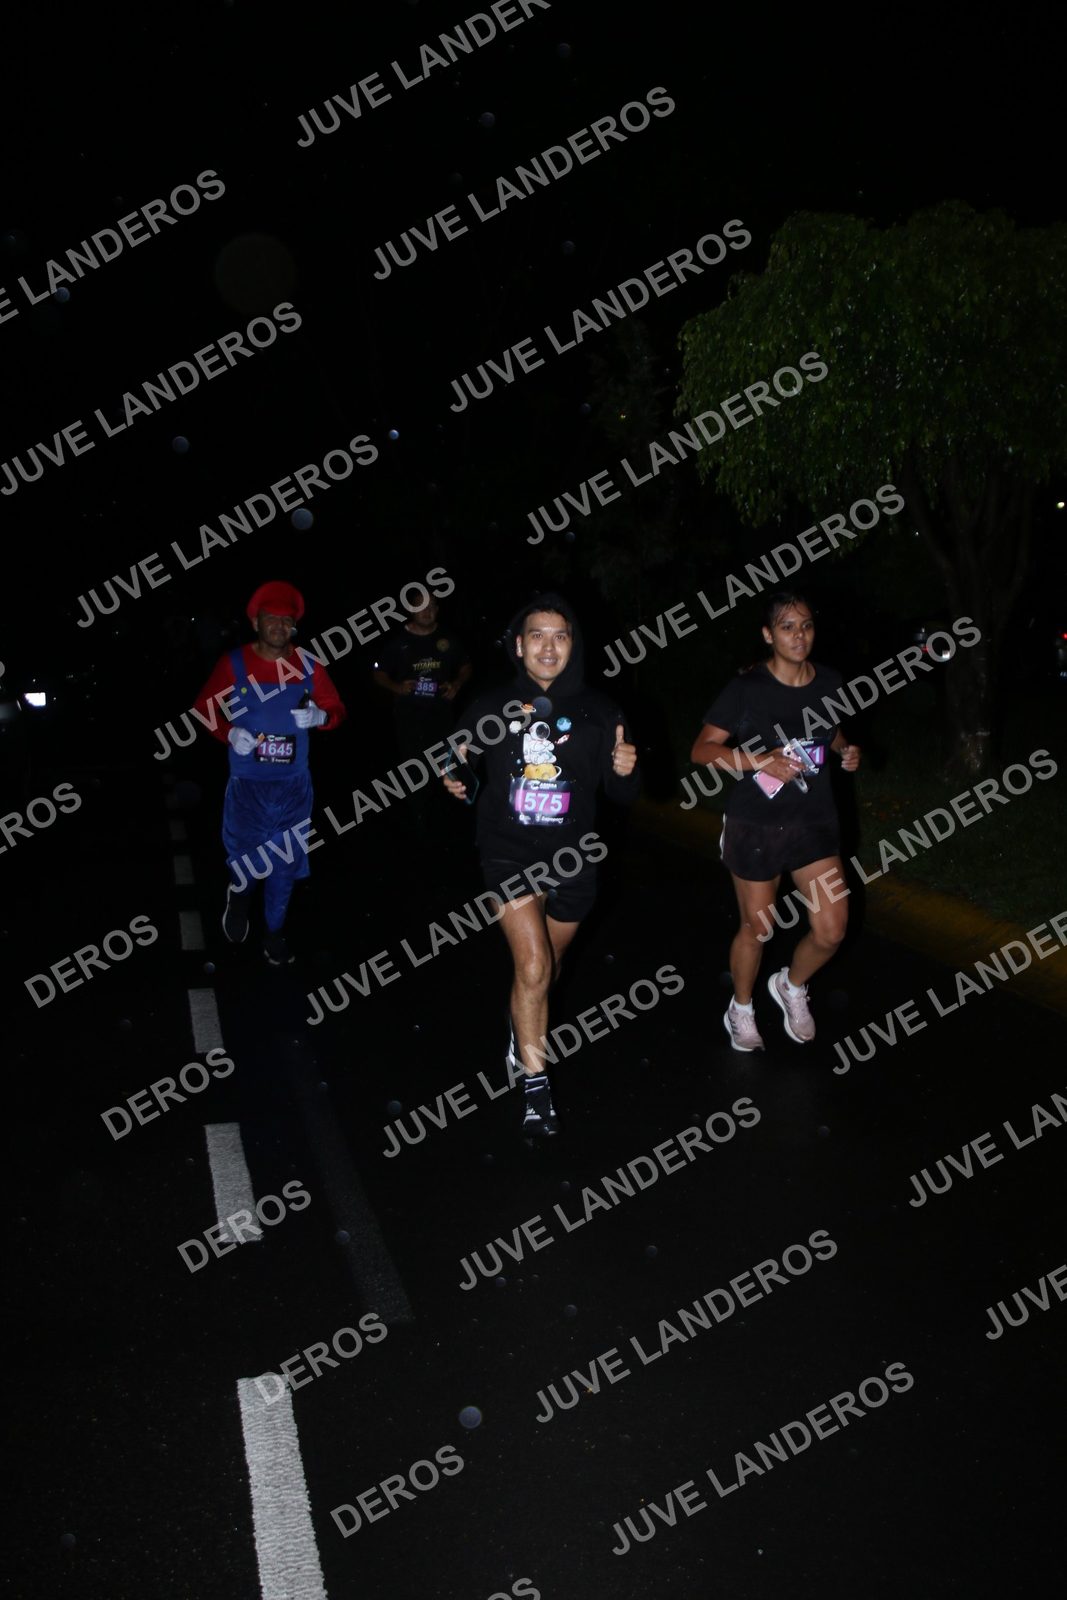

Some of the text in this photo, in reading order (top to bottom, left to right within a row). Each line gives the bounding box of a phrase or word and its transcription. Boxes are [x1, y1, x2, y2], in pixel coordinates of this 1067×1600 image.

[417, 682, 434, 692] 385
[260, 742, 293, 756] 1645
[524, 792, 563, 814] 575
